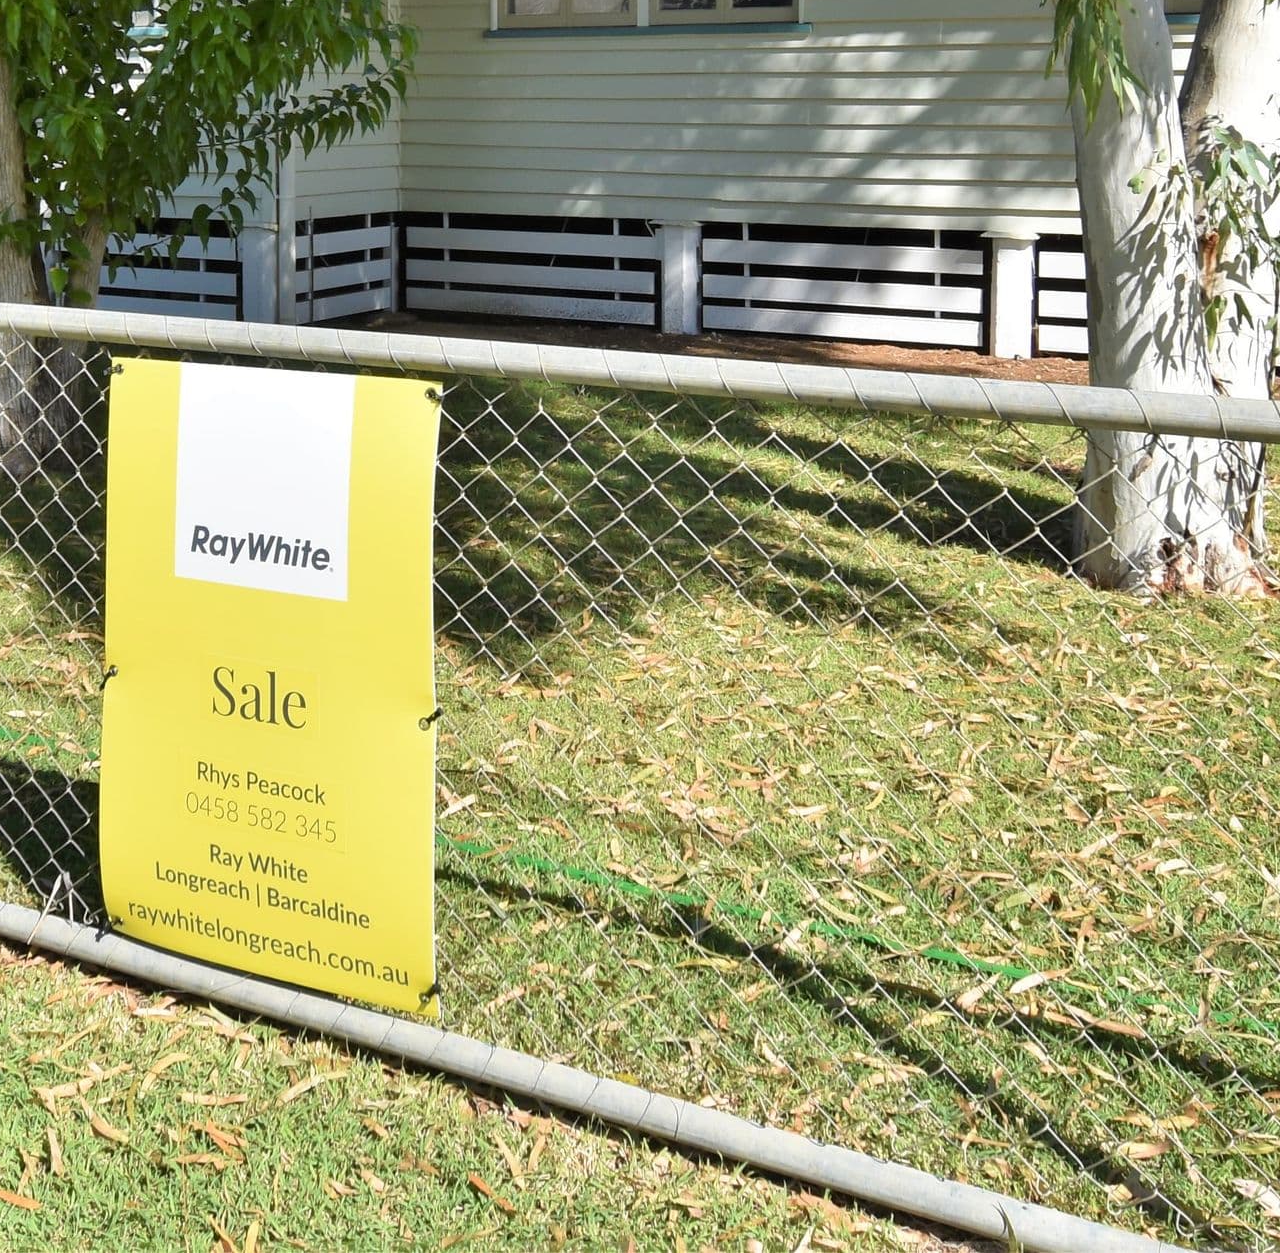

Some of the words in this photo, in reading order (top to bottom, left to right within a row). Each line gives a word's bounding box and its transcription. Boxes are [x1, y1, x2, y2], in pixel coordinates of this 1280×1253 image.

[212, 666, 307, 730] Sale
[197, 761, 240, 789] Rhys
[246, 771, 326, 806] Peacock
[186, 791, 239, 823] 0458
[247, 804, 287, 833] 582
[295, 814, 337, 844] 345
[209, 844, 243, 873] Ray
[248, 852, 308, 884] White
[155, 861, 250, 902] Longreach
[267, 887, 371, 930] Barcaldine
[128, 901, 409, 987] raywhitelongreach.com.au
